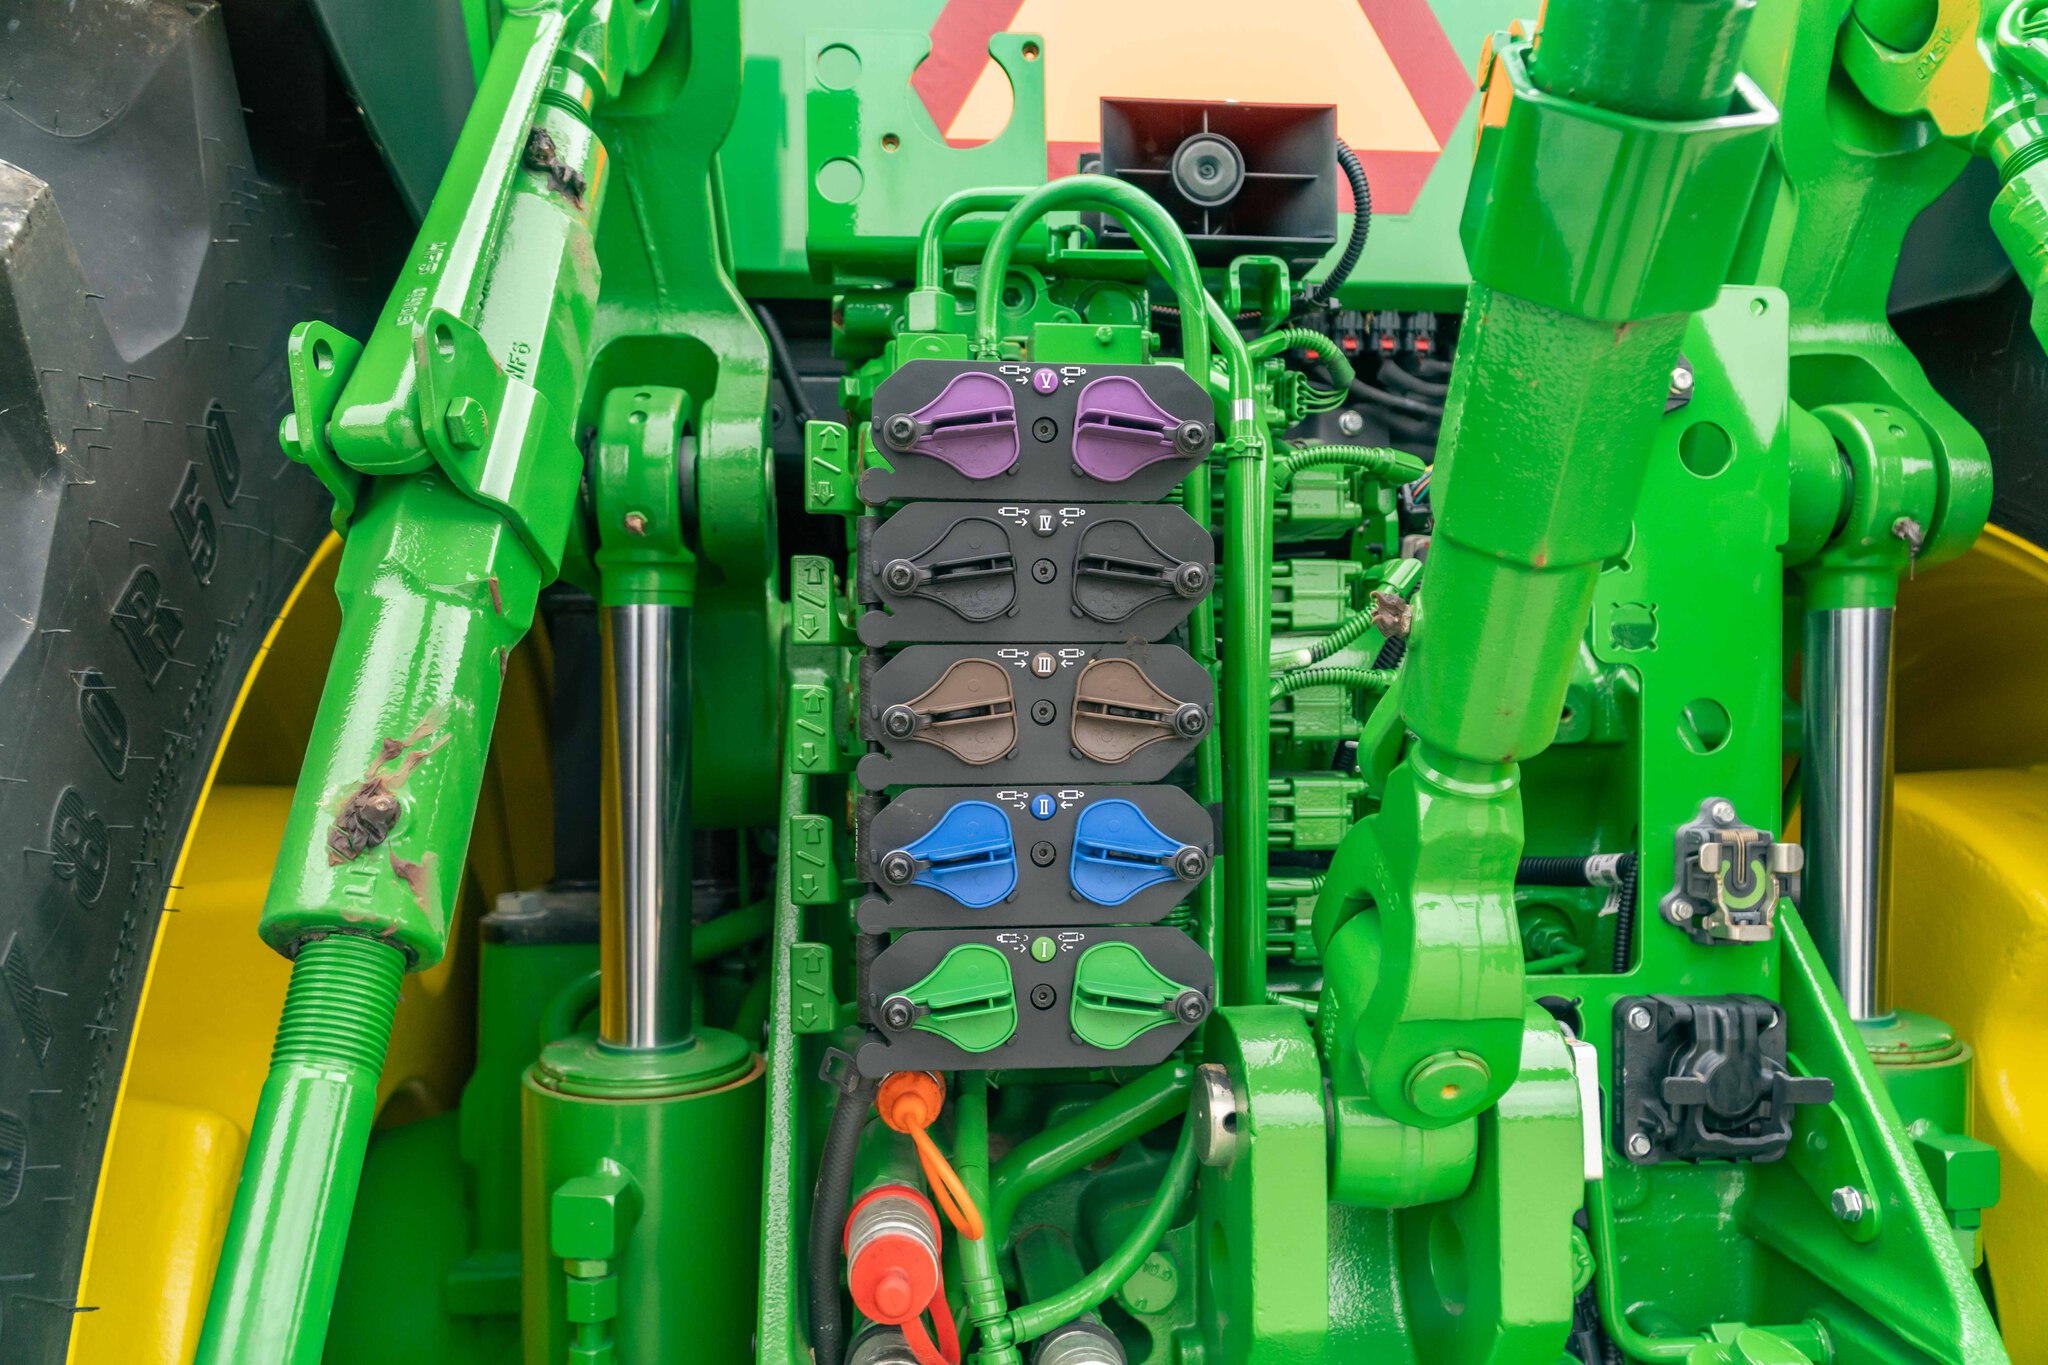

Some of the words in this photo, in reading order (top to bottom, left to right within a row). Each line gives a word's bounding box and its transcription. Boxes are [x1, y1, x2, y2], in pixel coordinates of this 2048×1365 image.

[1040, 372, 1053, 389] V
[1039, 515, 1052, 531] IV
[1038, 657, 1052, 673] III
[1039, 799, 1049, 815] II
[1041, 942, 1047, 957] I
